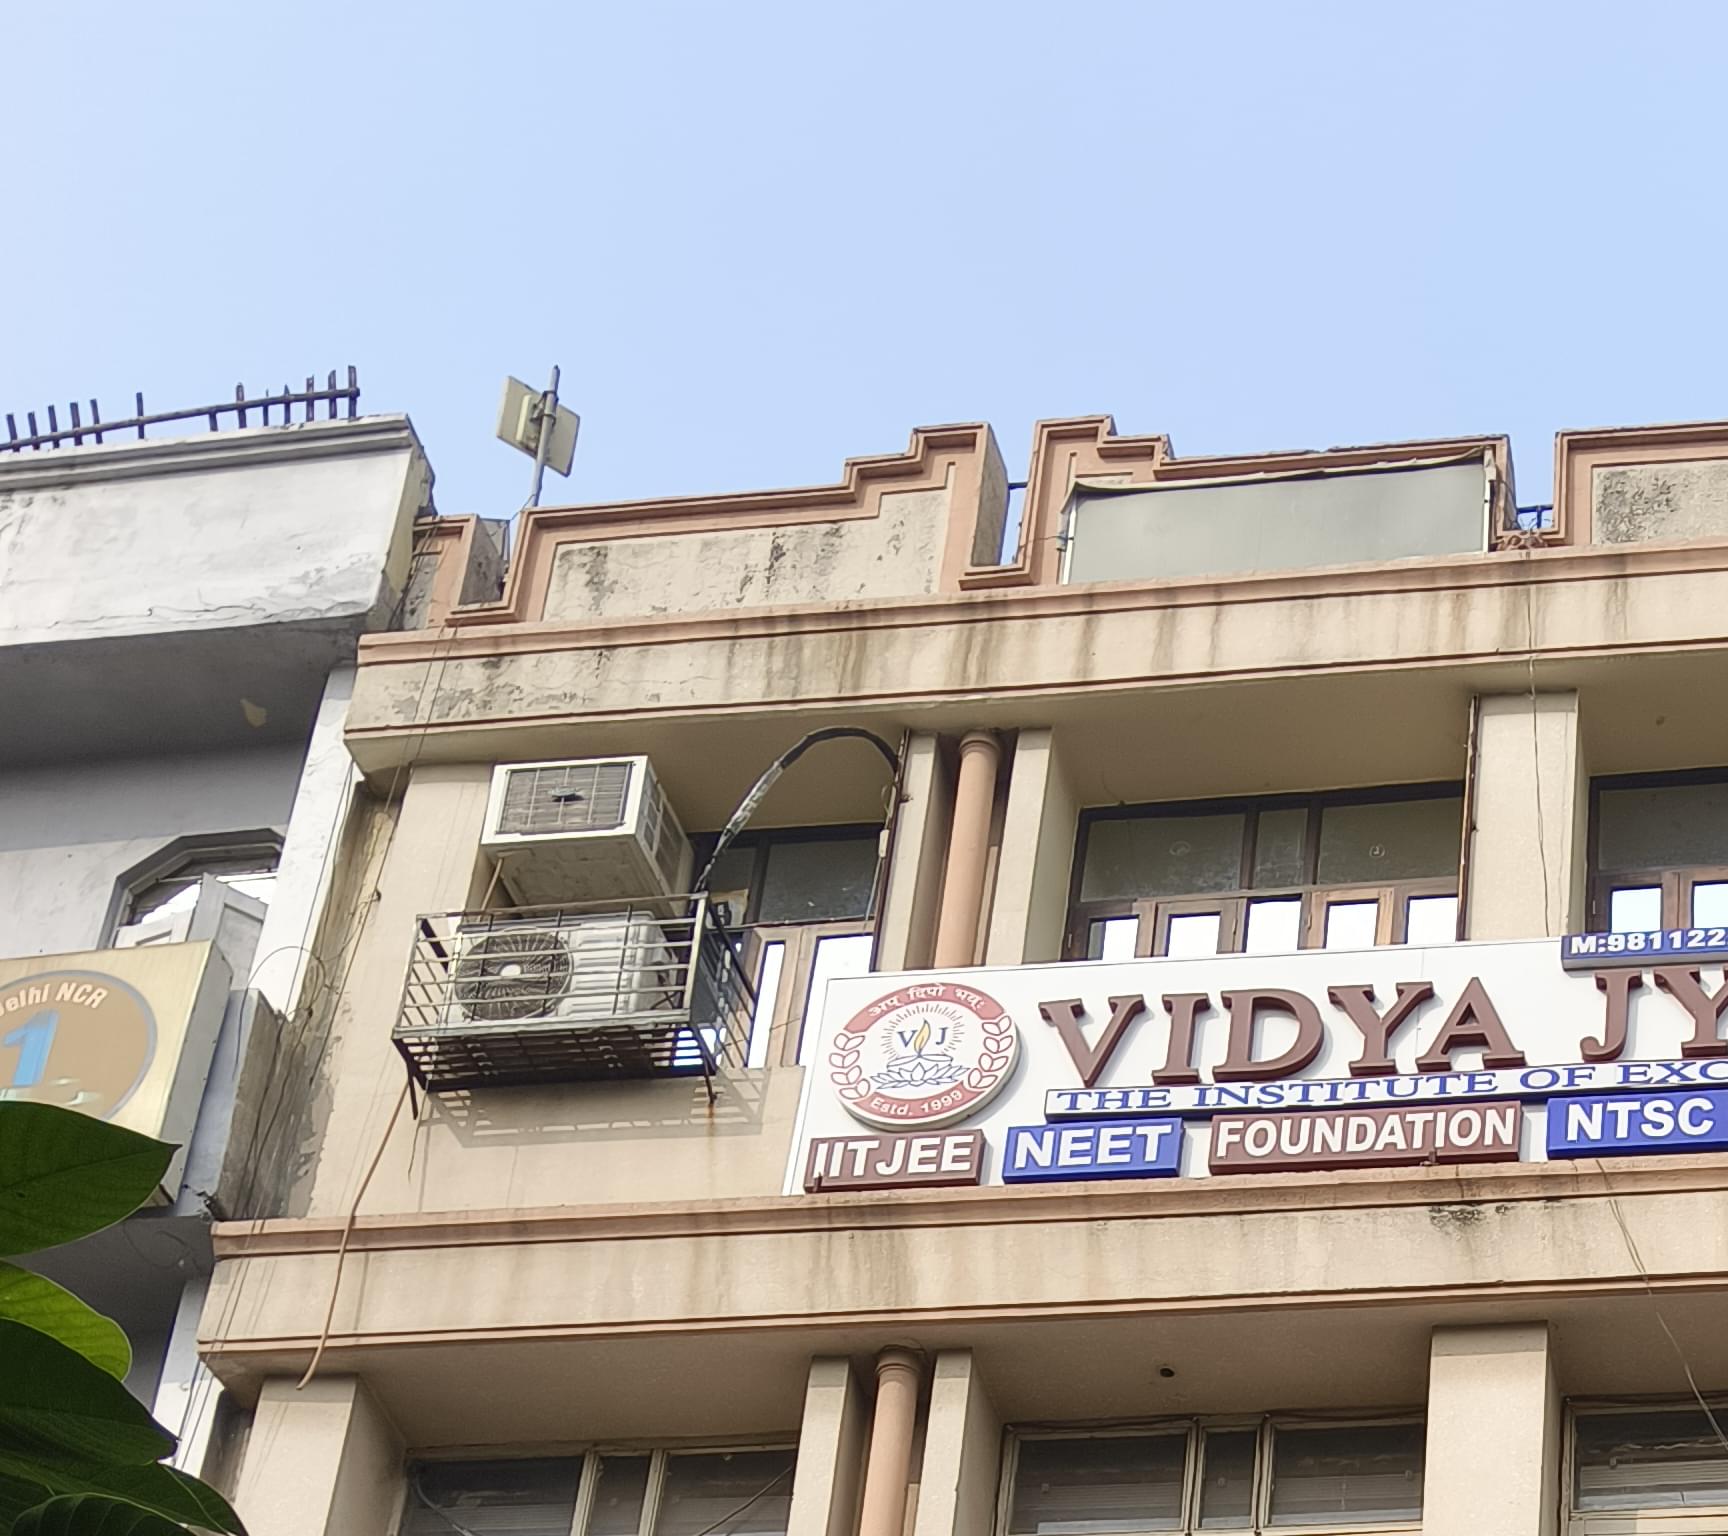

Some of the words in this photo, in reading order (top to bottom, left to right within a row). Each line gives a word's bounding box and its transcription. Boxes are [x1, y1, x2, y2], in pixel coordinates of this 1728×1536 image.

[56, 982, 108, 1008] NCR
[4, 1009, 60, 1088] 1
[1038, 976, 1526, 1087] VIDYA
[1057, 1088, 1172, 1112] THE
[1193, 1073, 1498, 1107] INSTITUTE
[1520, 1066, 1596, 1091] OF
[1216, 1109, 1515, 1158] FOUNDATION
[1566, 1098, 1714, 1141] NTSC
[1013, 1124, 1174, 1167] NEET
